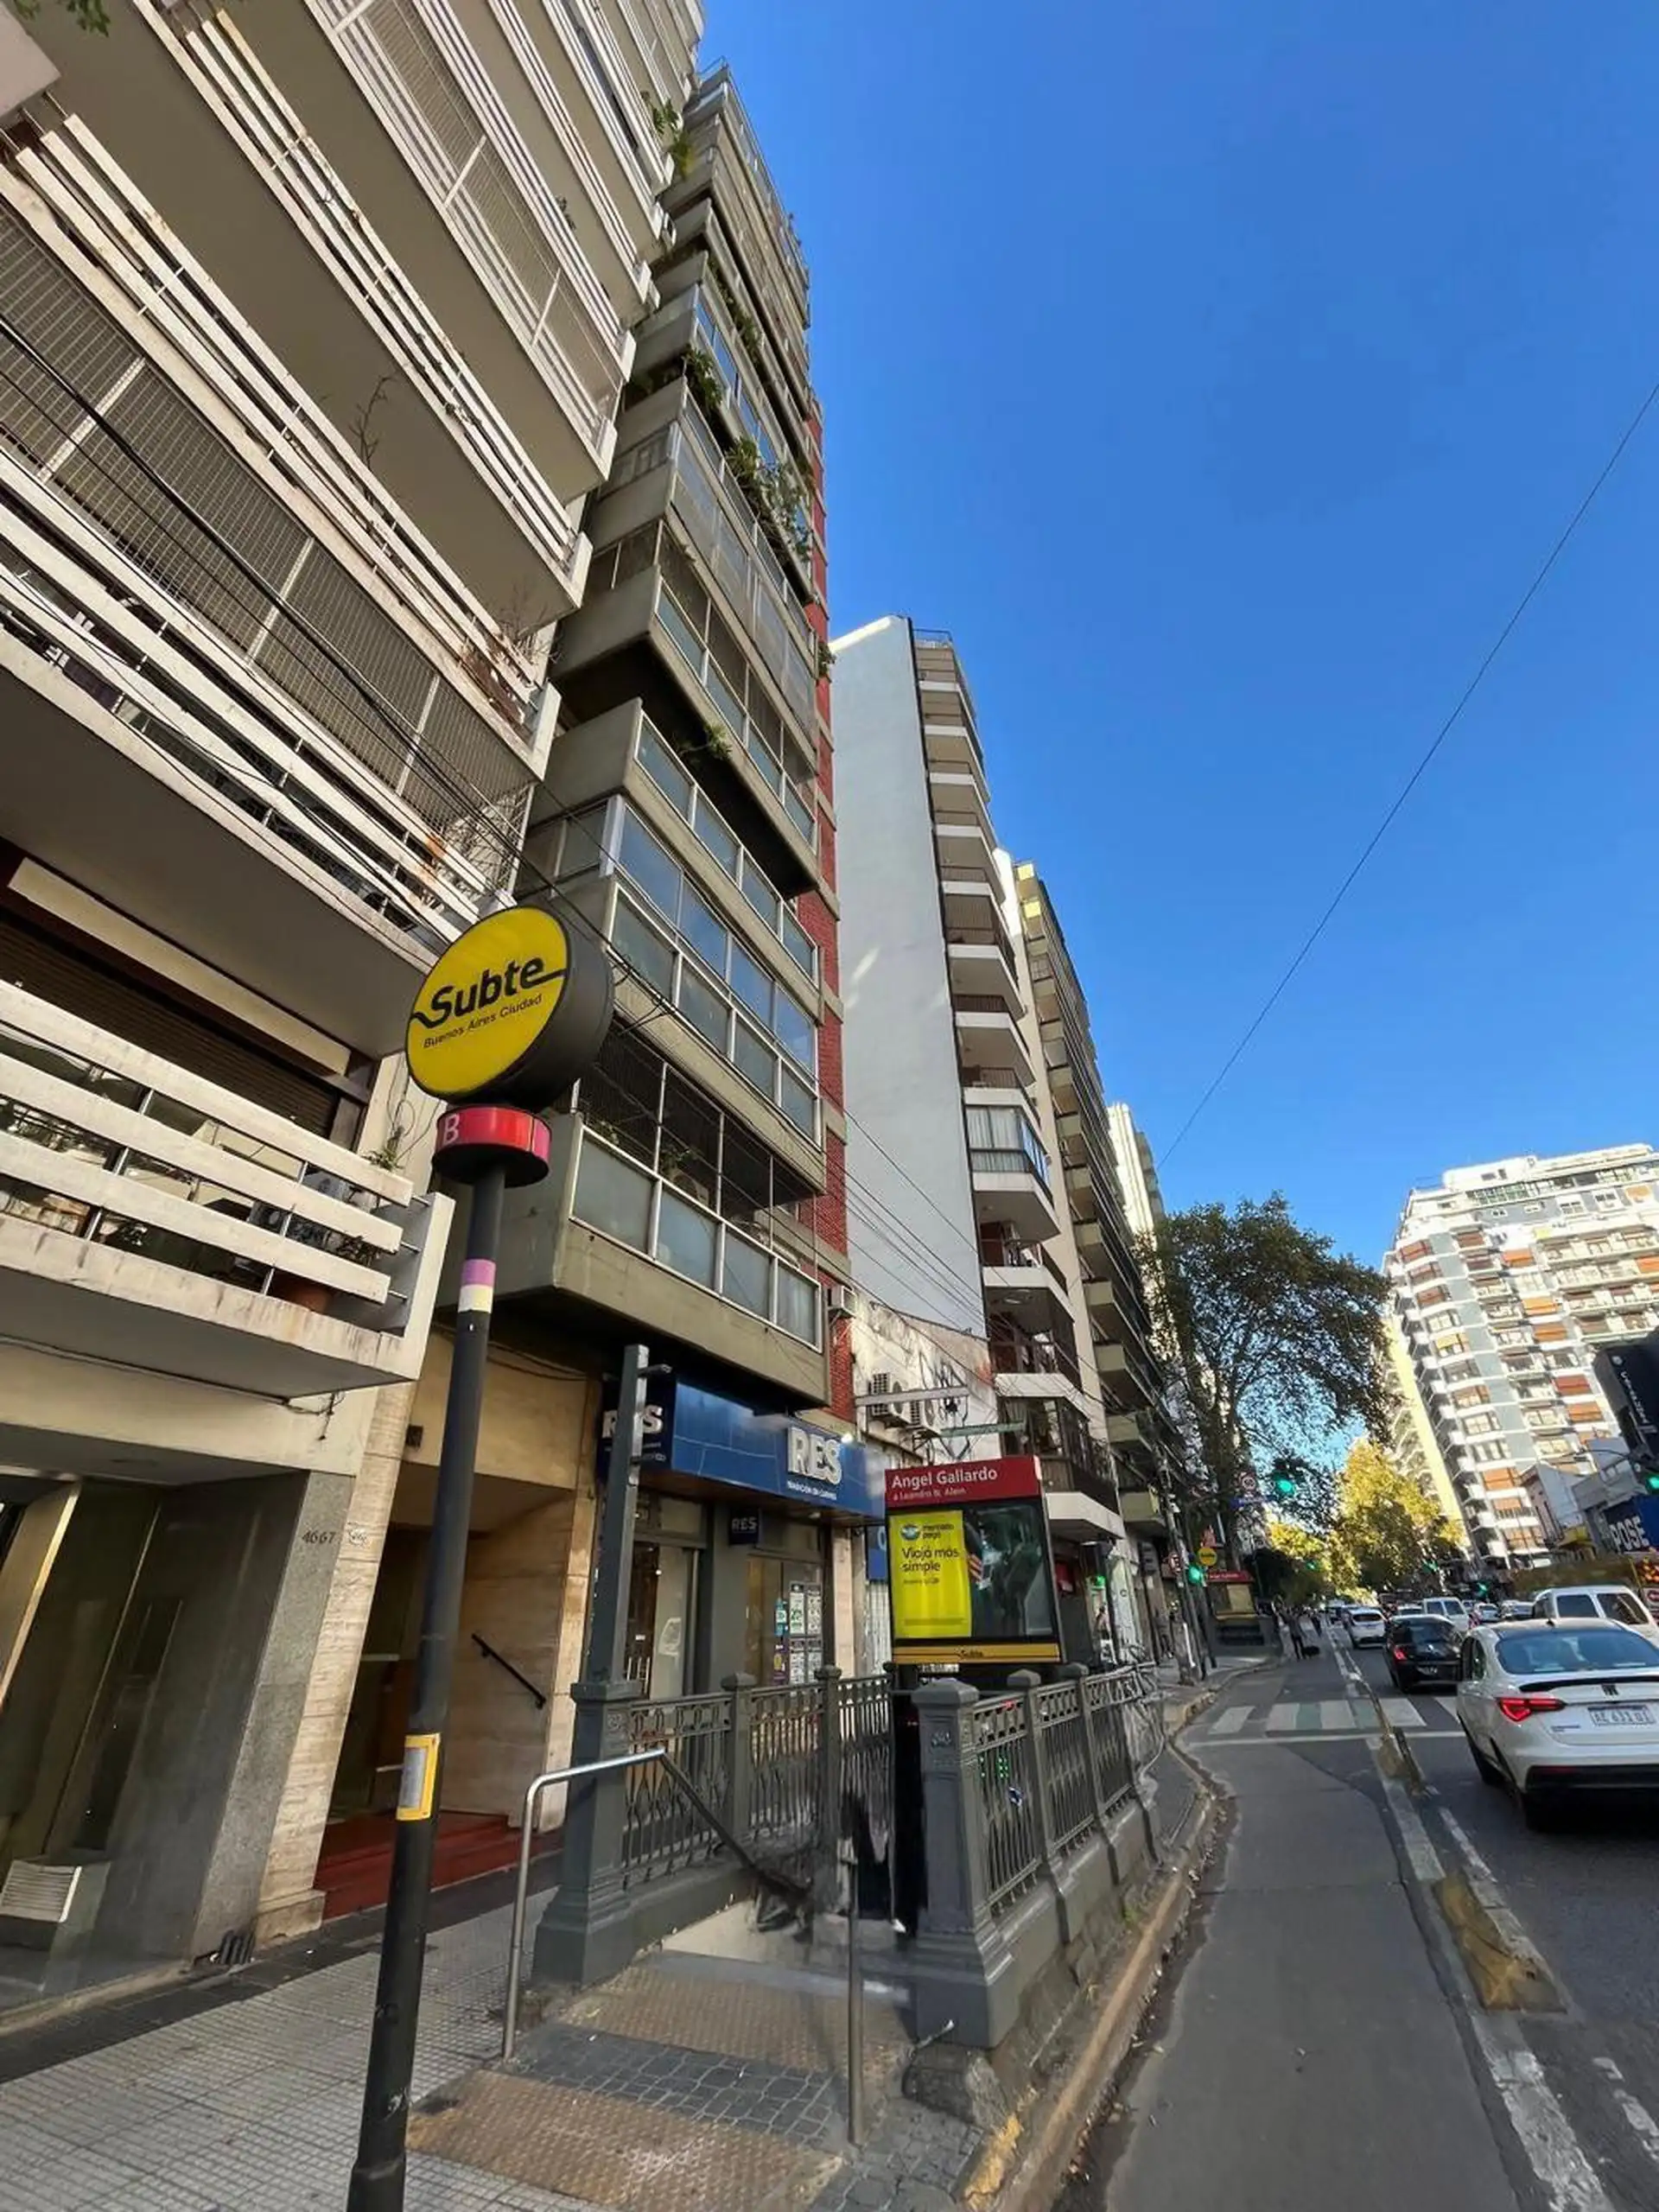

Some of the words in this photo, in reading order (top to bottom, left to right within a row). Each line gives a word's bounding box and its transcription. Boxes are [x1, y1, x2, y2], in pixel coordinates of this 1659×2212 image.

[416, 957, 563, 1028] Subte
[423, 1027, 465, 1048] Buenos
[467, 1014, 497, 1032] Aires
[499, 993, 543, 1018] Ciudad
[443, 1114, 460, 1145] B
[602, 1405, 663, 1439] RS
[787, 1427, 842, 1484] RES
[892, 1471, 932, 1491] Angel
[937, 1466, 997, 1484] Gallardo
[302, 1530, 336, 1544] 4667
[732, 1516, 757, 1530] RES
[902, 1560, 941, 1576] simple
